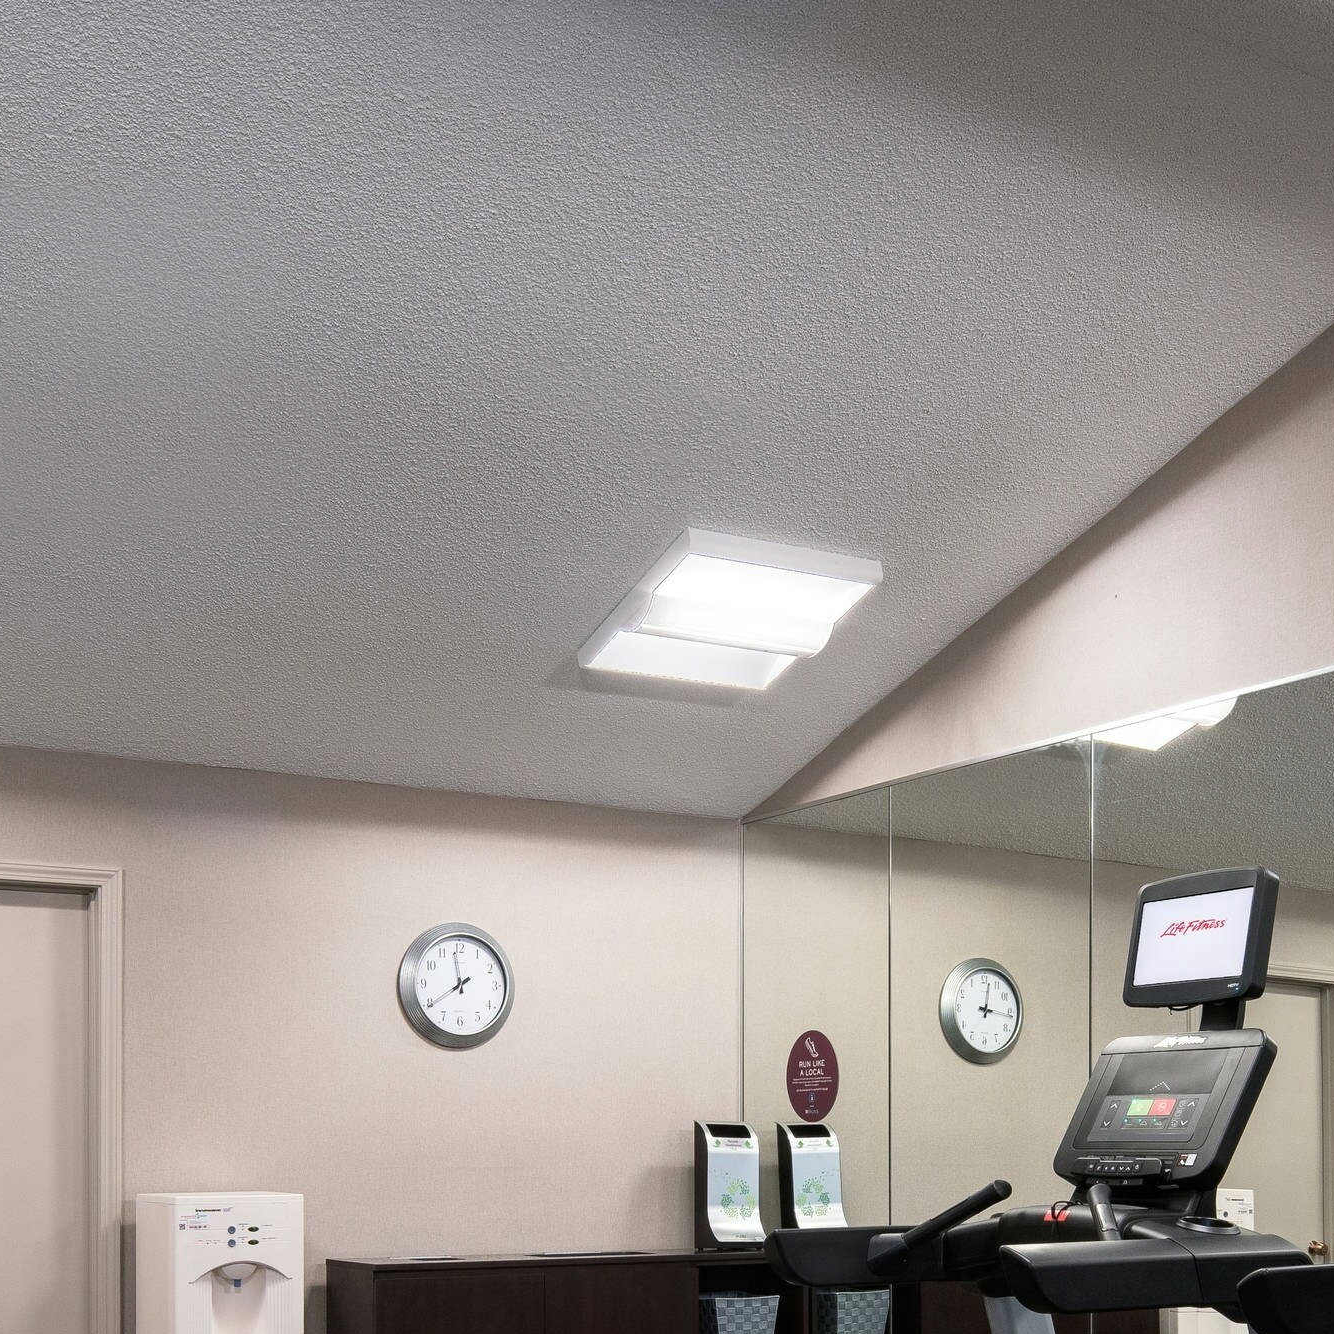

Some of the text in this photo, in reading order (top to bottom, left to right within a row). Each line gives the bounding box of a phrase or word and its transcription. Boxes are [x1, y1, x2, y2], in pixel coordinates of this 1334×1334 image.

[438, 948, 446, 958] 11
[455, 943, 465, 953] 12
[427, 960, 436, 971] 10
[420, 979, 427, 989] 9
[492, 980, 498, 991] 3
[457, 1016, 464, 1027] 6
